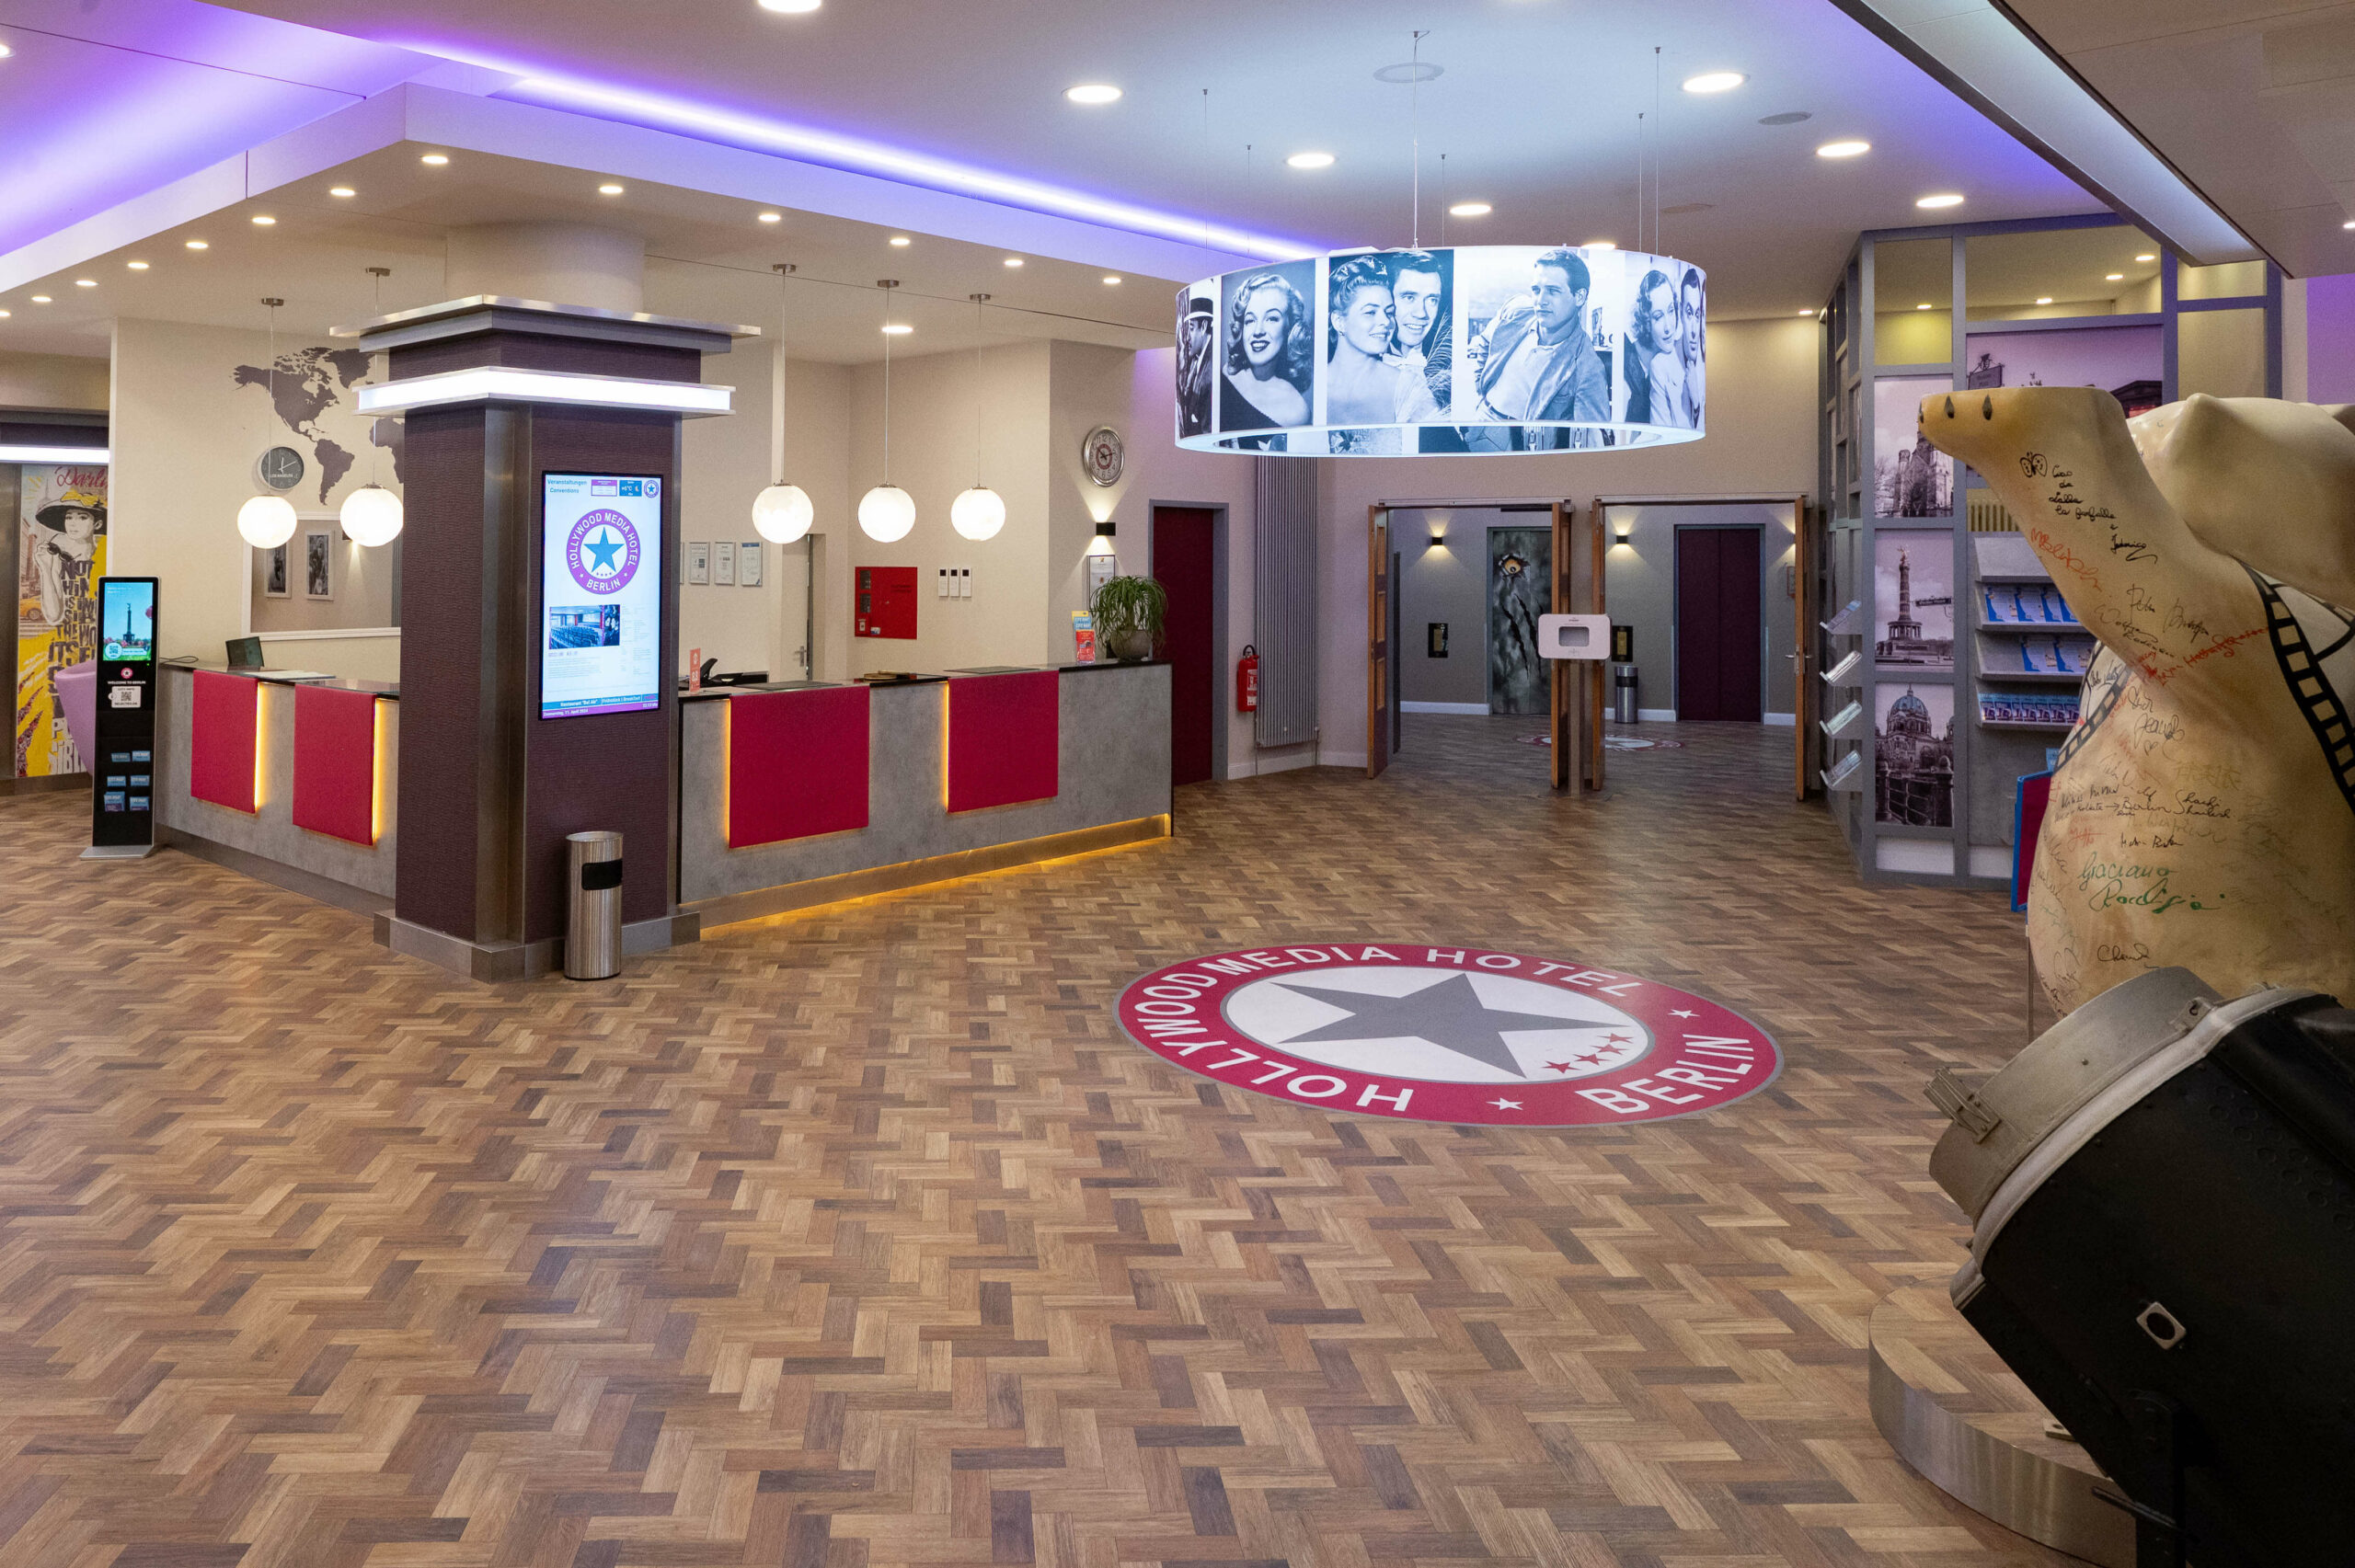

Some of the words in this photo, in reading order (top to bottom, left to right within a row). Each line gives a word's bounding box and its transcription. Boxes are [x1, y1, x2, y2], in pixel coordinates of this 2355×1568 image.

[547, 478, 588, 486] Veranstaltungen
[569, 512, 603, 569] HOLLYWOOD
[603, 512, 631, 534] MEDIA
[626, 532, 638, 567] HOTEL
[59, 560, 95, 580] NOT
[586, 578, 621, 591] BERLIN
[1200, 945, 1398, 979] MEDIA
[1426, 947, 1646, 998] HOTEL
[1134, 970, 1415, 1113] HOLLYWOOD
[1574, 1033, 1756, 1115] BERLIN
